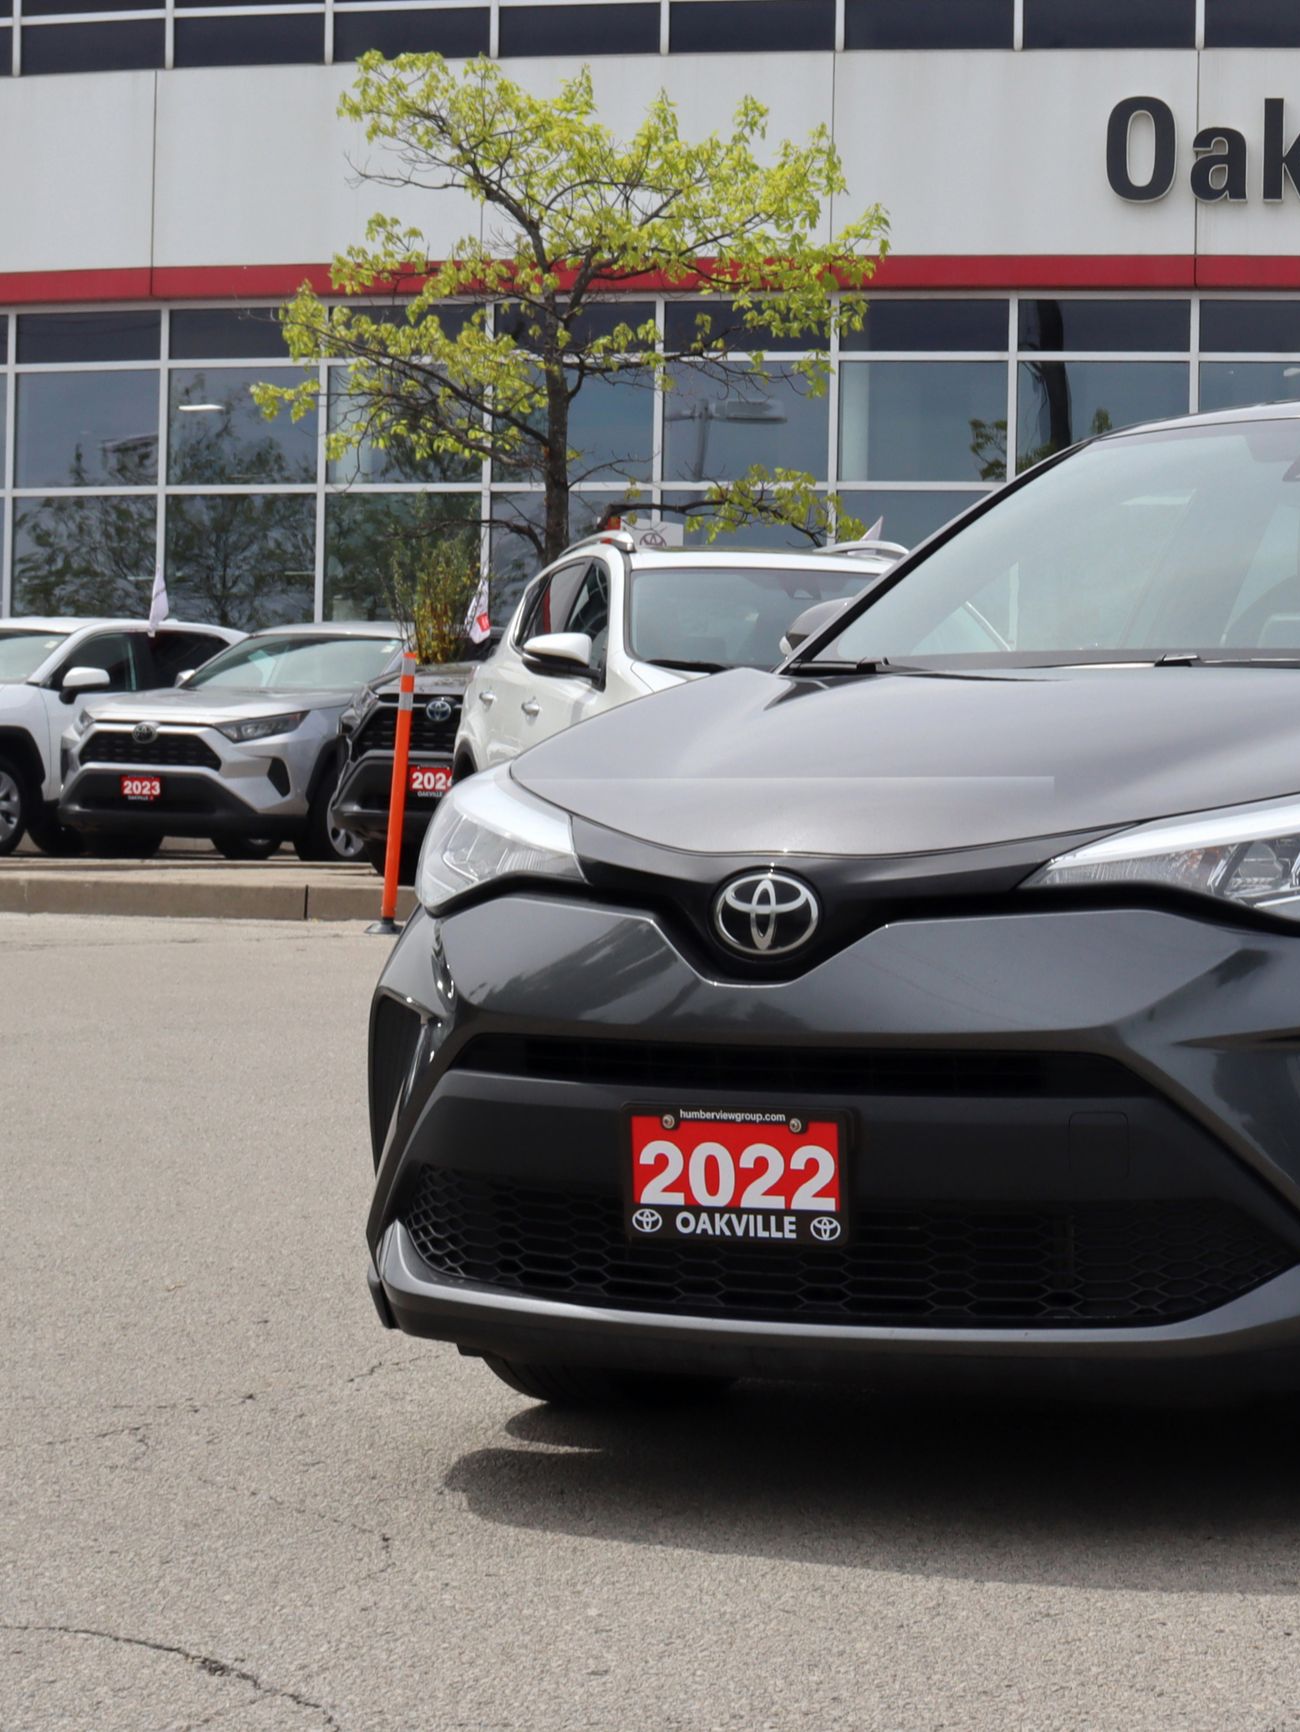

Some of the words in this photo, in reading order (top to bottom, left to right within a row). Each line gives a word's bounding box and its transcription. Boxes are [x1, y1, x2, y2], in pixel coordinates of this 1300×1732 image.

[123, 780, 160, 795] 2023
[679, 1108, 787, 1123] humberviewgroup.com
[639, 1140, 836, 1212] 2022
[675, 1211, 797, 1239] OAKVILLE
